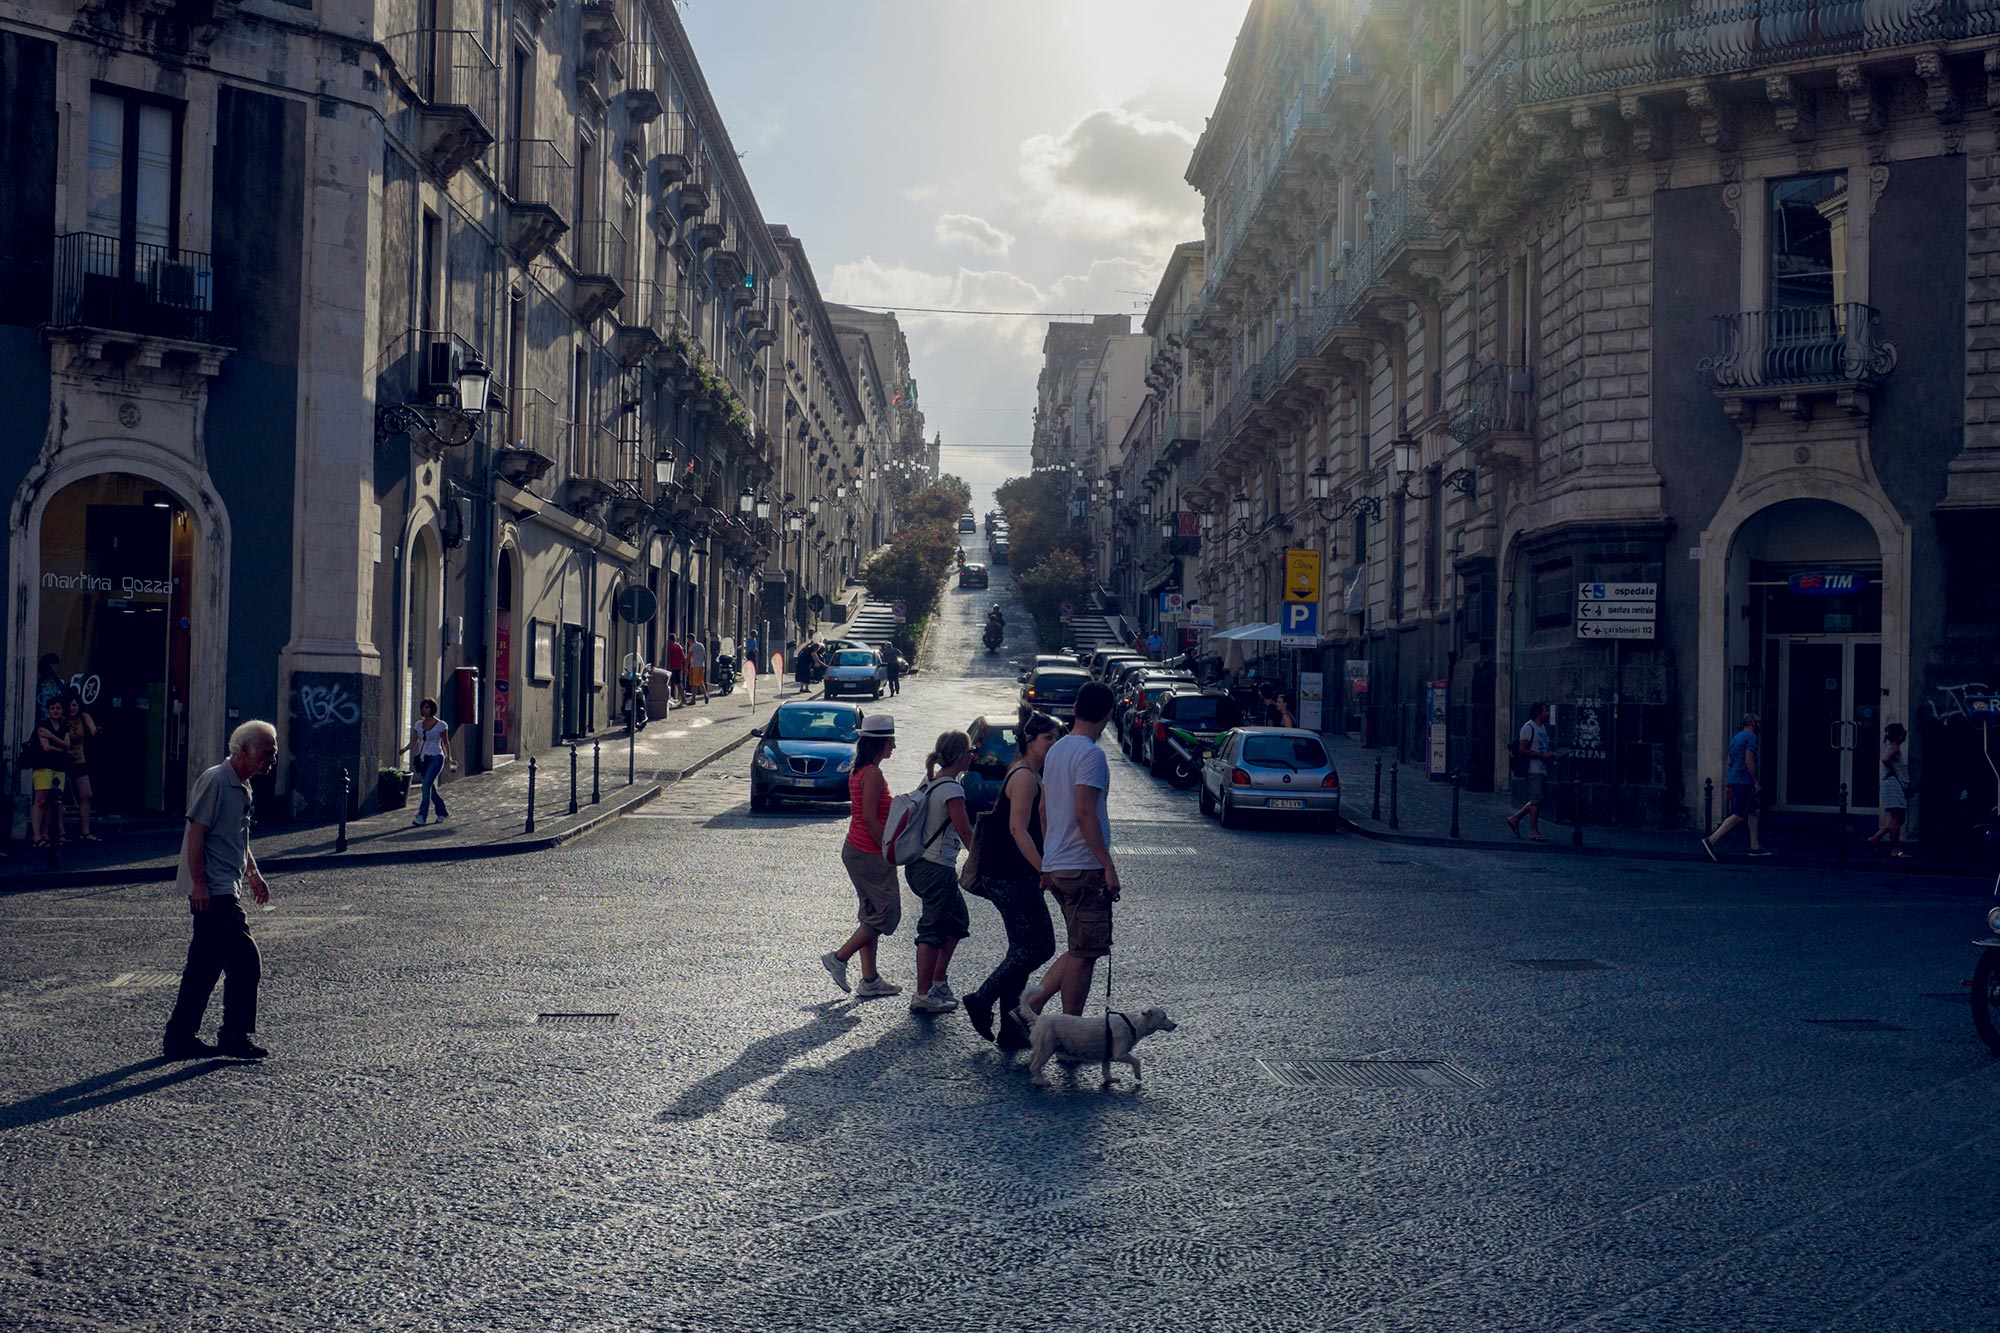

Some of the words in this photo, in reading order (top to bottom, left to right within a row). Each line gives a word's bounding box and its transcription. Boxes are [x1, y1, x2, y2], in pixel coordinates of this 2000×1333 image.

[1823, 574, 1854, 589] TIM
[1614, 587, 1655, 597] ospedale
[1607, 607, 1630, 615] questura
[1632, 606, 1654, 615] centrale
[1289, 604, 1310, 630] P
[1604, 626, 1641, 634] carabinieri
[1642, 626, 1653, 634] 112
